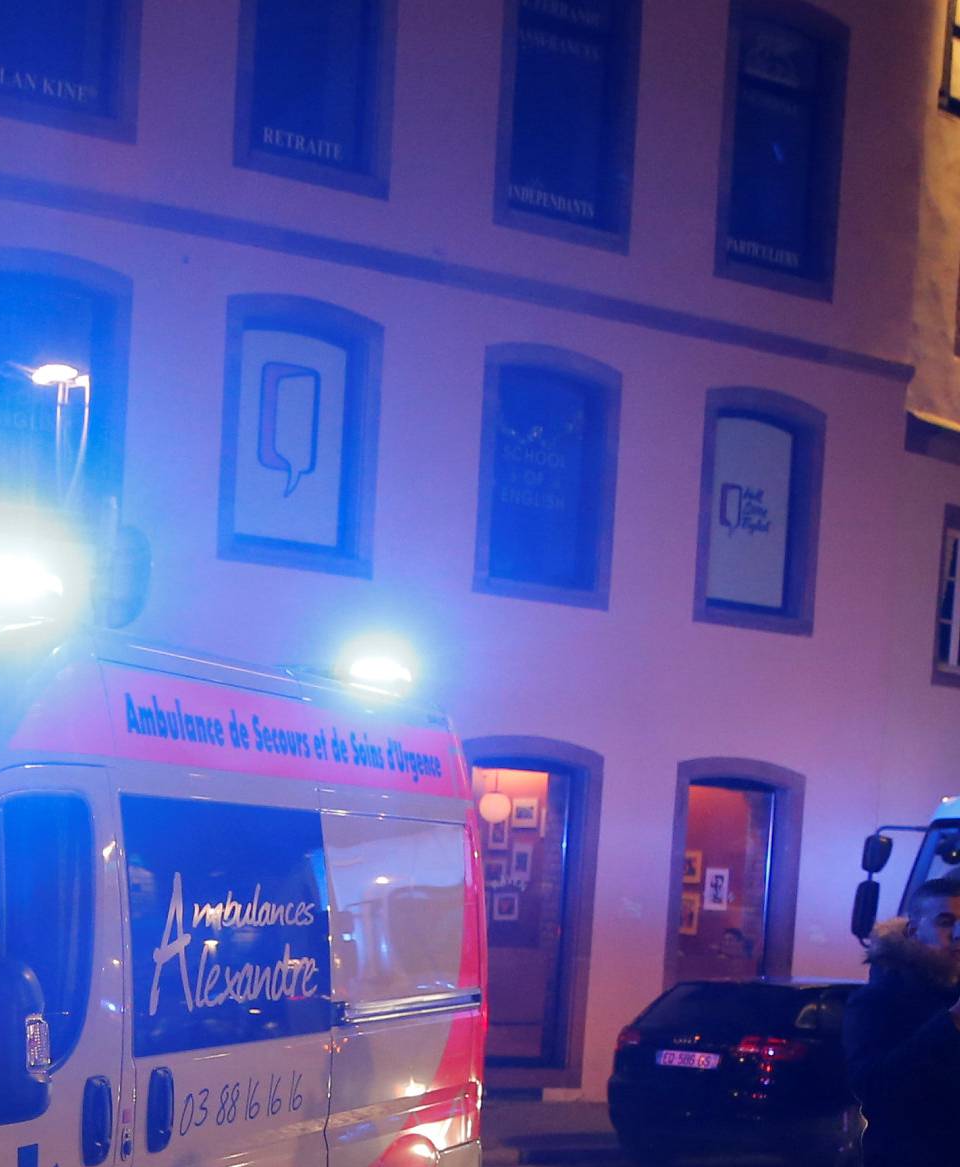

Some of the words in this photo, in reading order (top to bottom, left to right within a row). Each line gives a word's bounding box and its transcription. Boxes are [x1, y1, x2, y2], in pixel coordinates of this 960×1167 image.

[262, 127, 344, 161] RETRAITE
[124, 692, 225, 747] Ambulance
[229, 708, 251, 750] de
[252, 713, 310, 759] Secours
[314, 728, 329, 761] et
[331, 726, 349, 765] de
[350, 730, 385, 771] Soins
[387, 737, 443, 784] d'Urgence
[149, 872, 316, 958] Ambulances
[179, 1087, 210, 1138] 03
[215, 1081, 241, 1127] 88
[244, 1076, 261, 1121] 16
[266, 1072, 282, 1117] 16
[287, 1070, 303, 1113] 16
